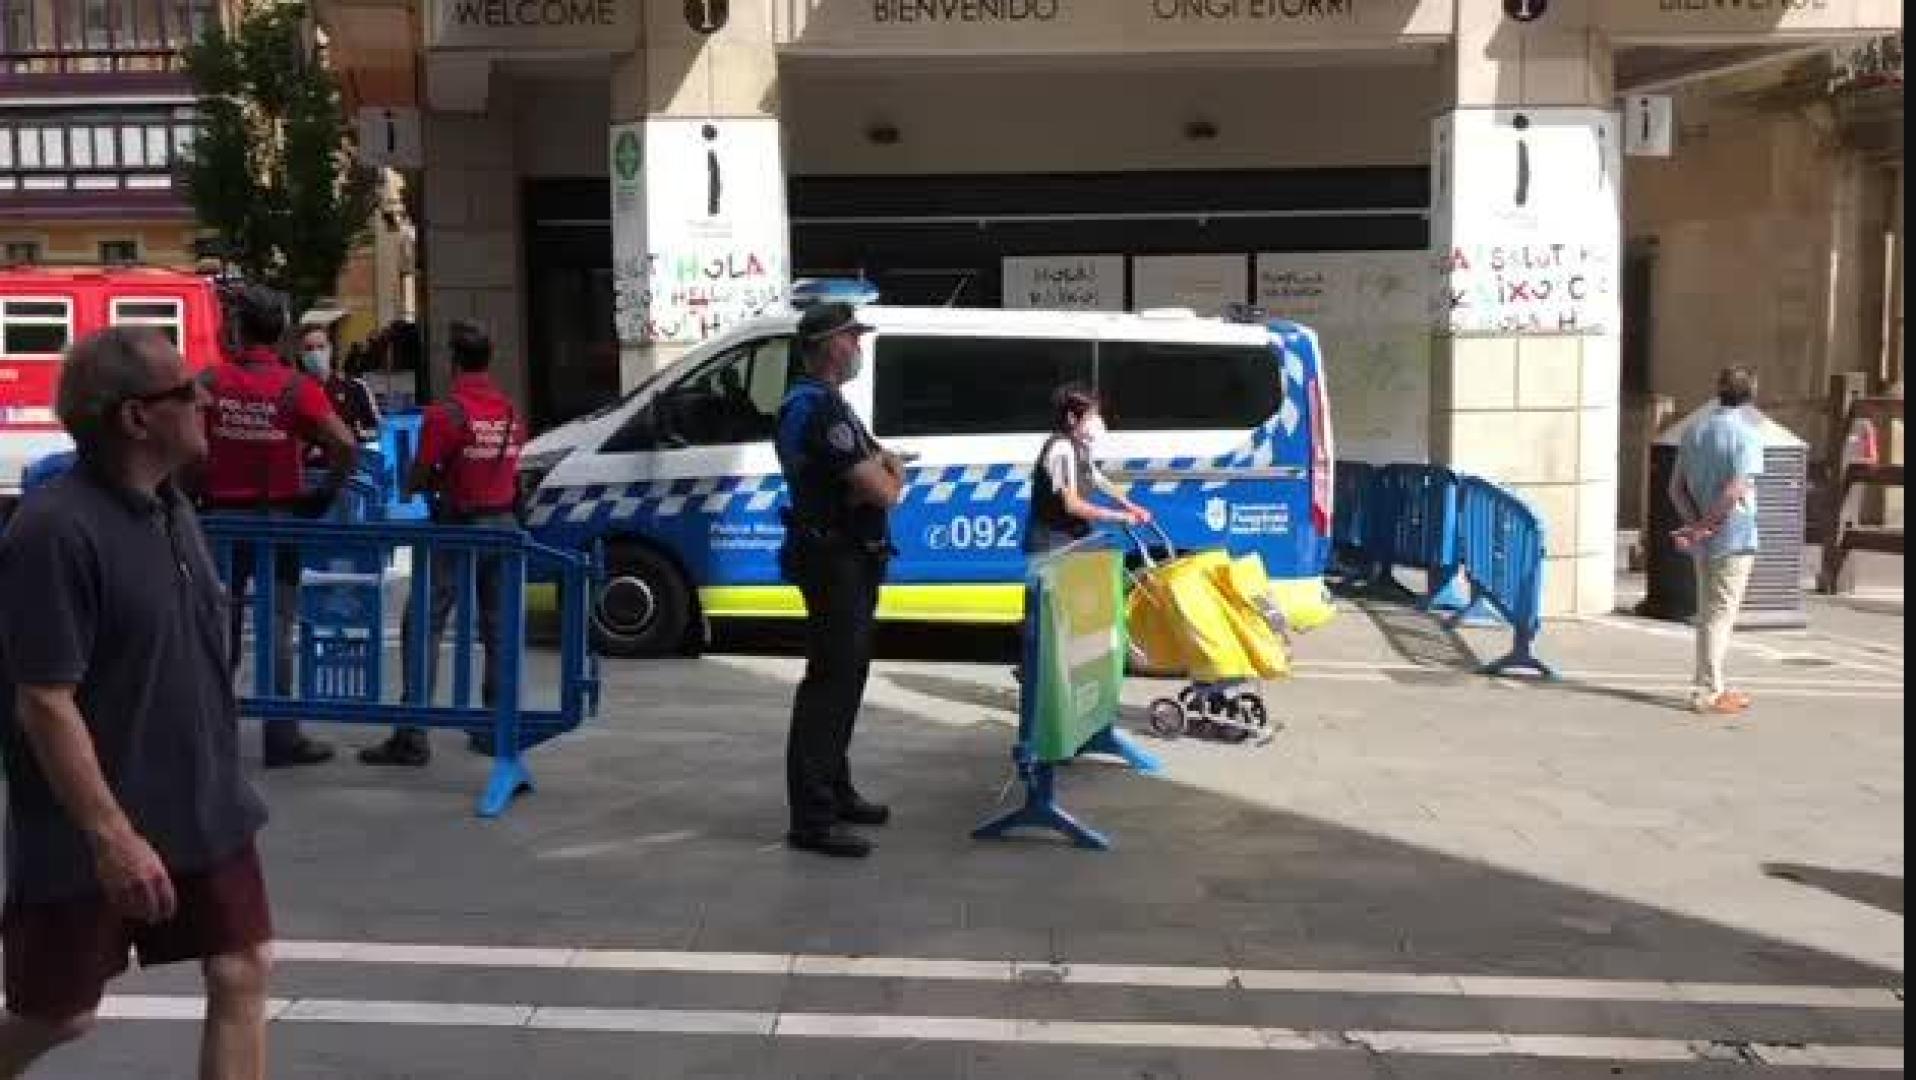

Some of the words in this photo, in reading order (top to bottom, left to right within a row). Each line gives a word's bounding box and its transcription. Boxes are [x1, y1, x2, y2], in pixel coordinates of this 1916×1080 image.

[457, 0, 616, 25] WELCOME
[873, 0, 1058, 22] BIENVENIDO
[951, 515, 1017, 549] 092
